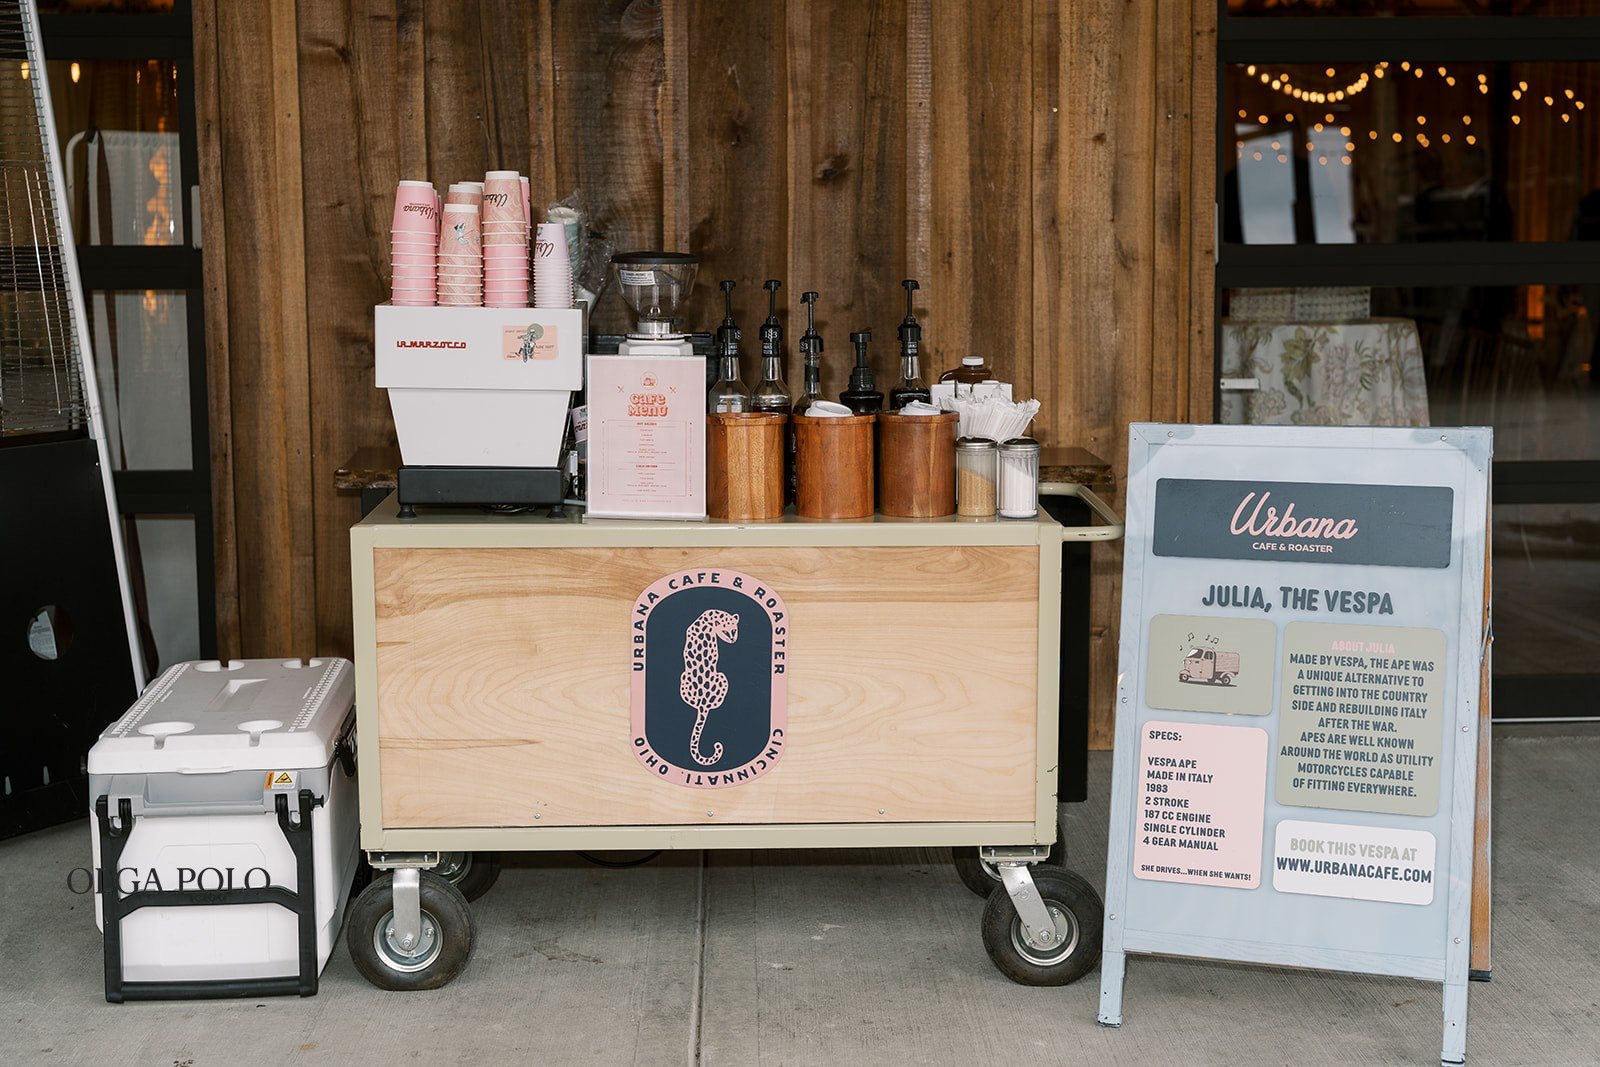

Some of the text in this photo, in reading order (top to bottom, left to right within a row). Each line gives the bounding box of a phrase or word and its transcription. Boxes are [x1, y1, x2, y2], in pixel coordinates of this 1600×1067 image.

[403, 204, 434, 220] Urbana
[410, 341, 467, 349] MARZOCCO
[1230, 491, 1359, 539] Urbana
[1252, 542, 1333, 553] CAFE & ROASTER
[1202, 585, 1394, 615] JULIA, THE VESPA
[633, 573, 786, 674] URBANA CAFE & ROASTER
[1331, 640, 1395, 653] ABOUT JULIA
[1290, 654, 1435, 671] MADE BY VESPA, THE APE WAS
[1298, 670, 1425, 687] A UNIQUE ALTERNATIVE TO
[1293, 685, 1428, 703] GETTING INTO THE COUNTRY
[1292, 700, 1428, 719] SIDE AND REBUILDING ITALY
[1318, 717, 1398, 732] AFTER THE WAR.
[1149, 731, 1182, 741] SPECS:
[1301, 732, 1414, 749] APES ARE WELL KNOWN
[634, 737, 669, 775] OHIO
[1148, 757, 1197, 769] VESPA APE
[1281, 746, 1434, 766] AROUND THE WORLD AS UTILITY
[1147, 770, 1214, 783] MADE IN ITALY
[1298, 763, 1414, 781] MOTORCYCLES CAPABLE
[1146, 783, 1168, 793] 1983
[1293, 778, 1417, 797] OF FITTING EVERYWHERE.
[1146, 797, 1190, 808] 2 STROKE
[1145, 810, 1212, 824] 187 CC ENGINE
[1144, 823, 1226, 838] SINGLE CYLINDER
[1143, 836, 1219, 851] 4 GEAR MANUAL
[1291, 838, 1418, 861] BOOK THIS VESPA AT
[1209, 871, 1224, 879] SHE
[1224, 872, 1252, 881] WANTS!
[1277, 857, 1432, 884] WWW.URBANACAFE.COM
